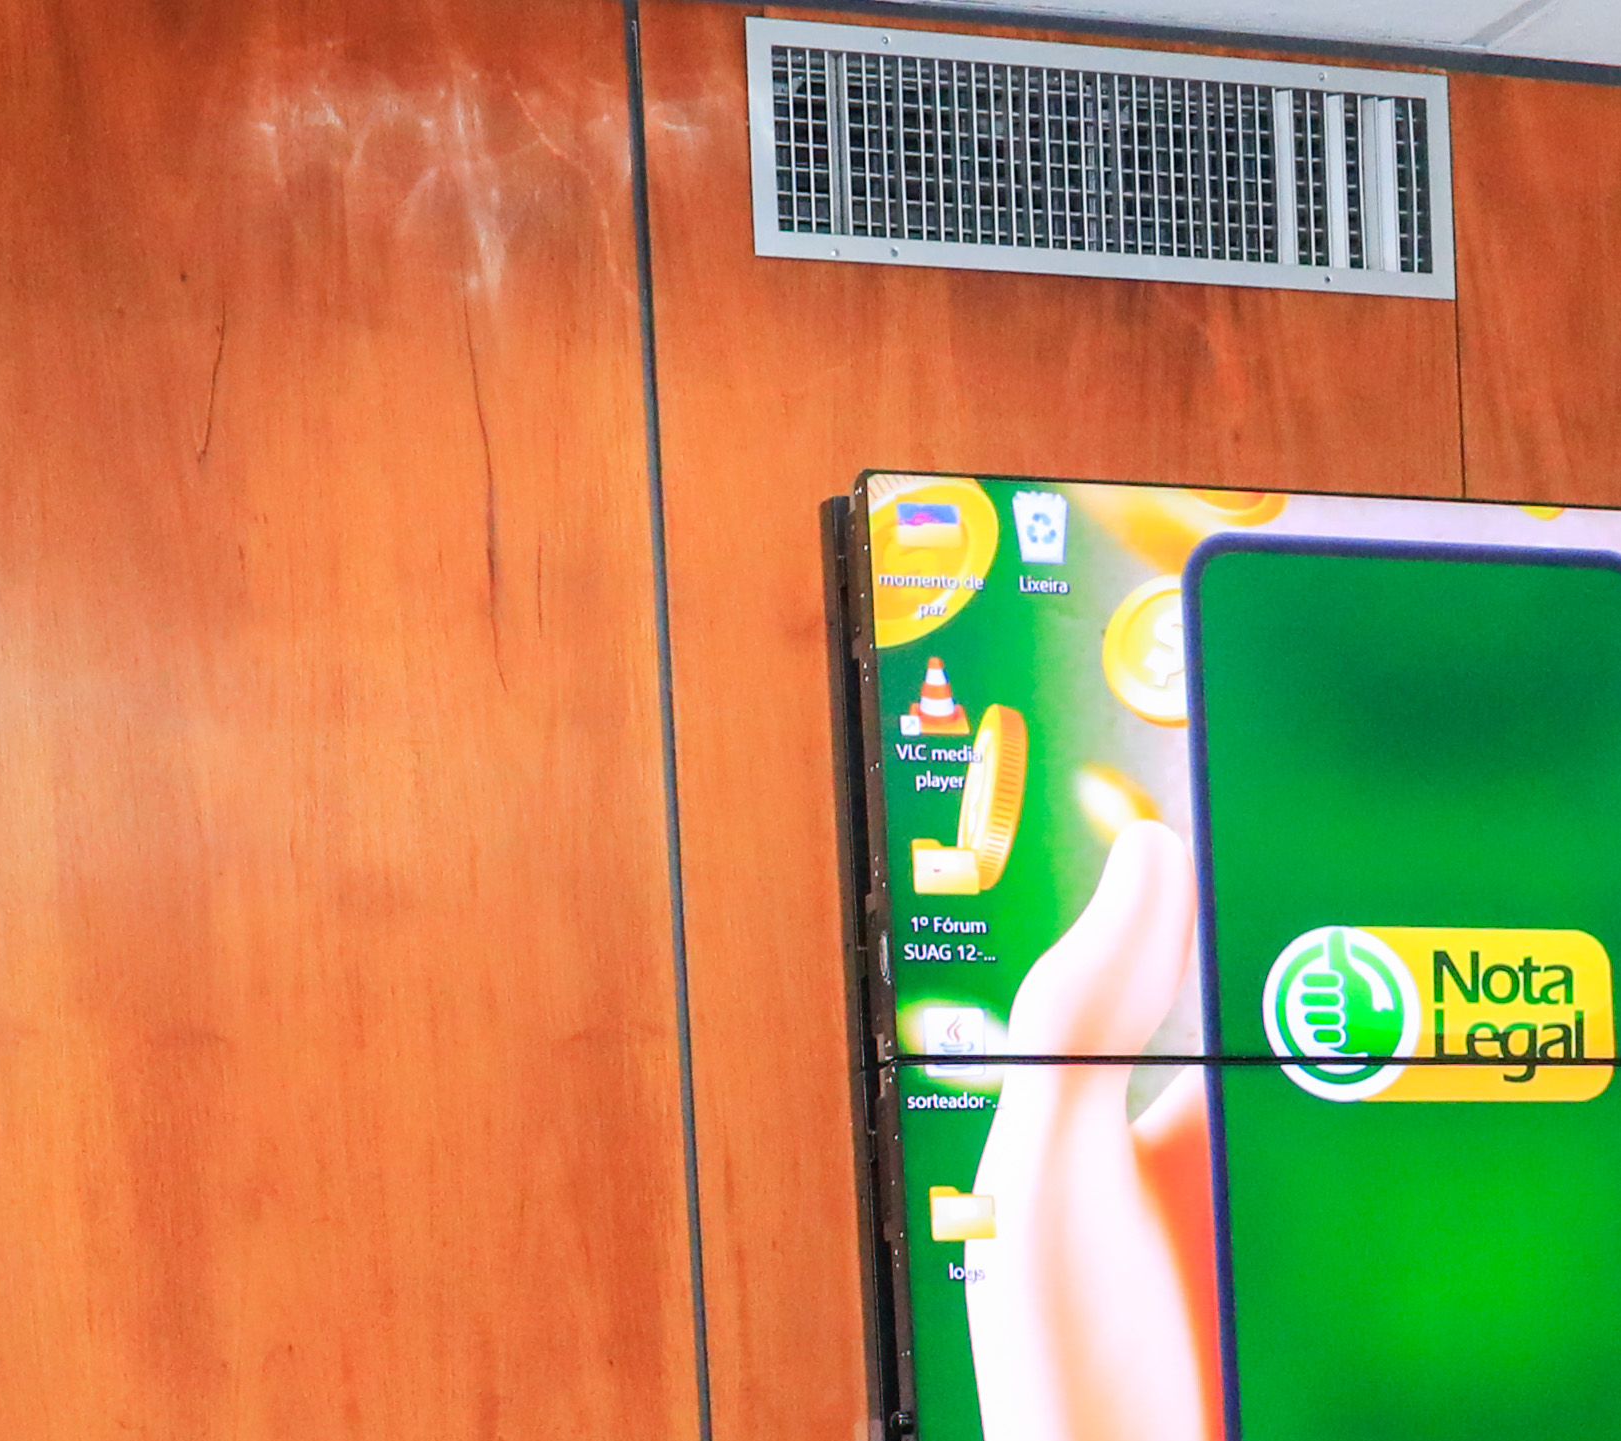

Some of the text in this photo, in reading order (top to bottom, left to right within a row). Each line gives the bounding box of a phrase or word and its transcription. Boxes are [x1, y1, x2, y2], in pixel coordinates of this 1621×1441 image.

[878, 573, 984, 590] momento de
[1019, 575, 1069, 594] Lixeira
[916, 603, 947, 620] paz
[895, 743, 982, 762] VLC media
[915, 770, 965, 792] player
[932, 916, 988, 933] Fórum
[903, 943, 952, 961] SUAG
[1433, 950, 1574, 1004] Nota
[1434, 1008, 1585, 1082] Legal
[948, 1262, 986, 1285] logs
